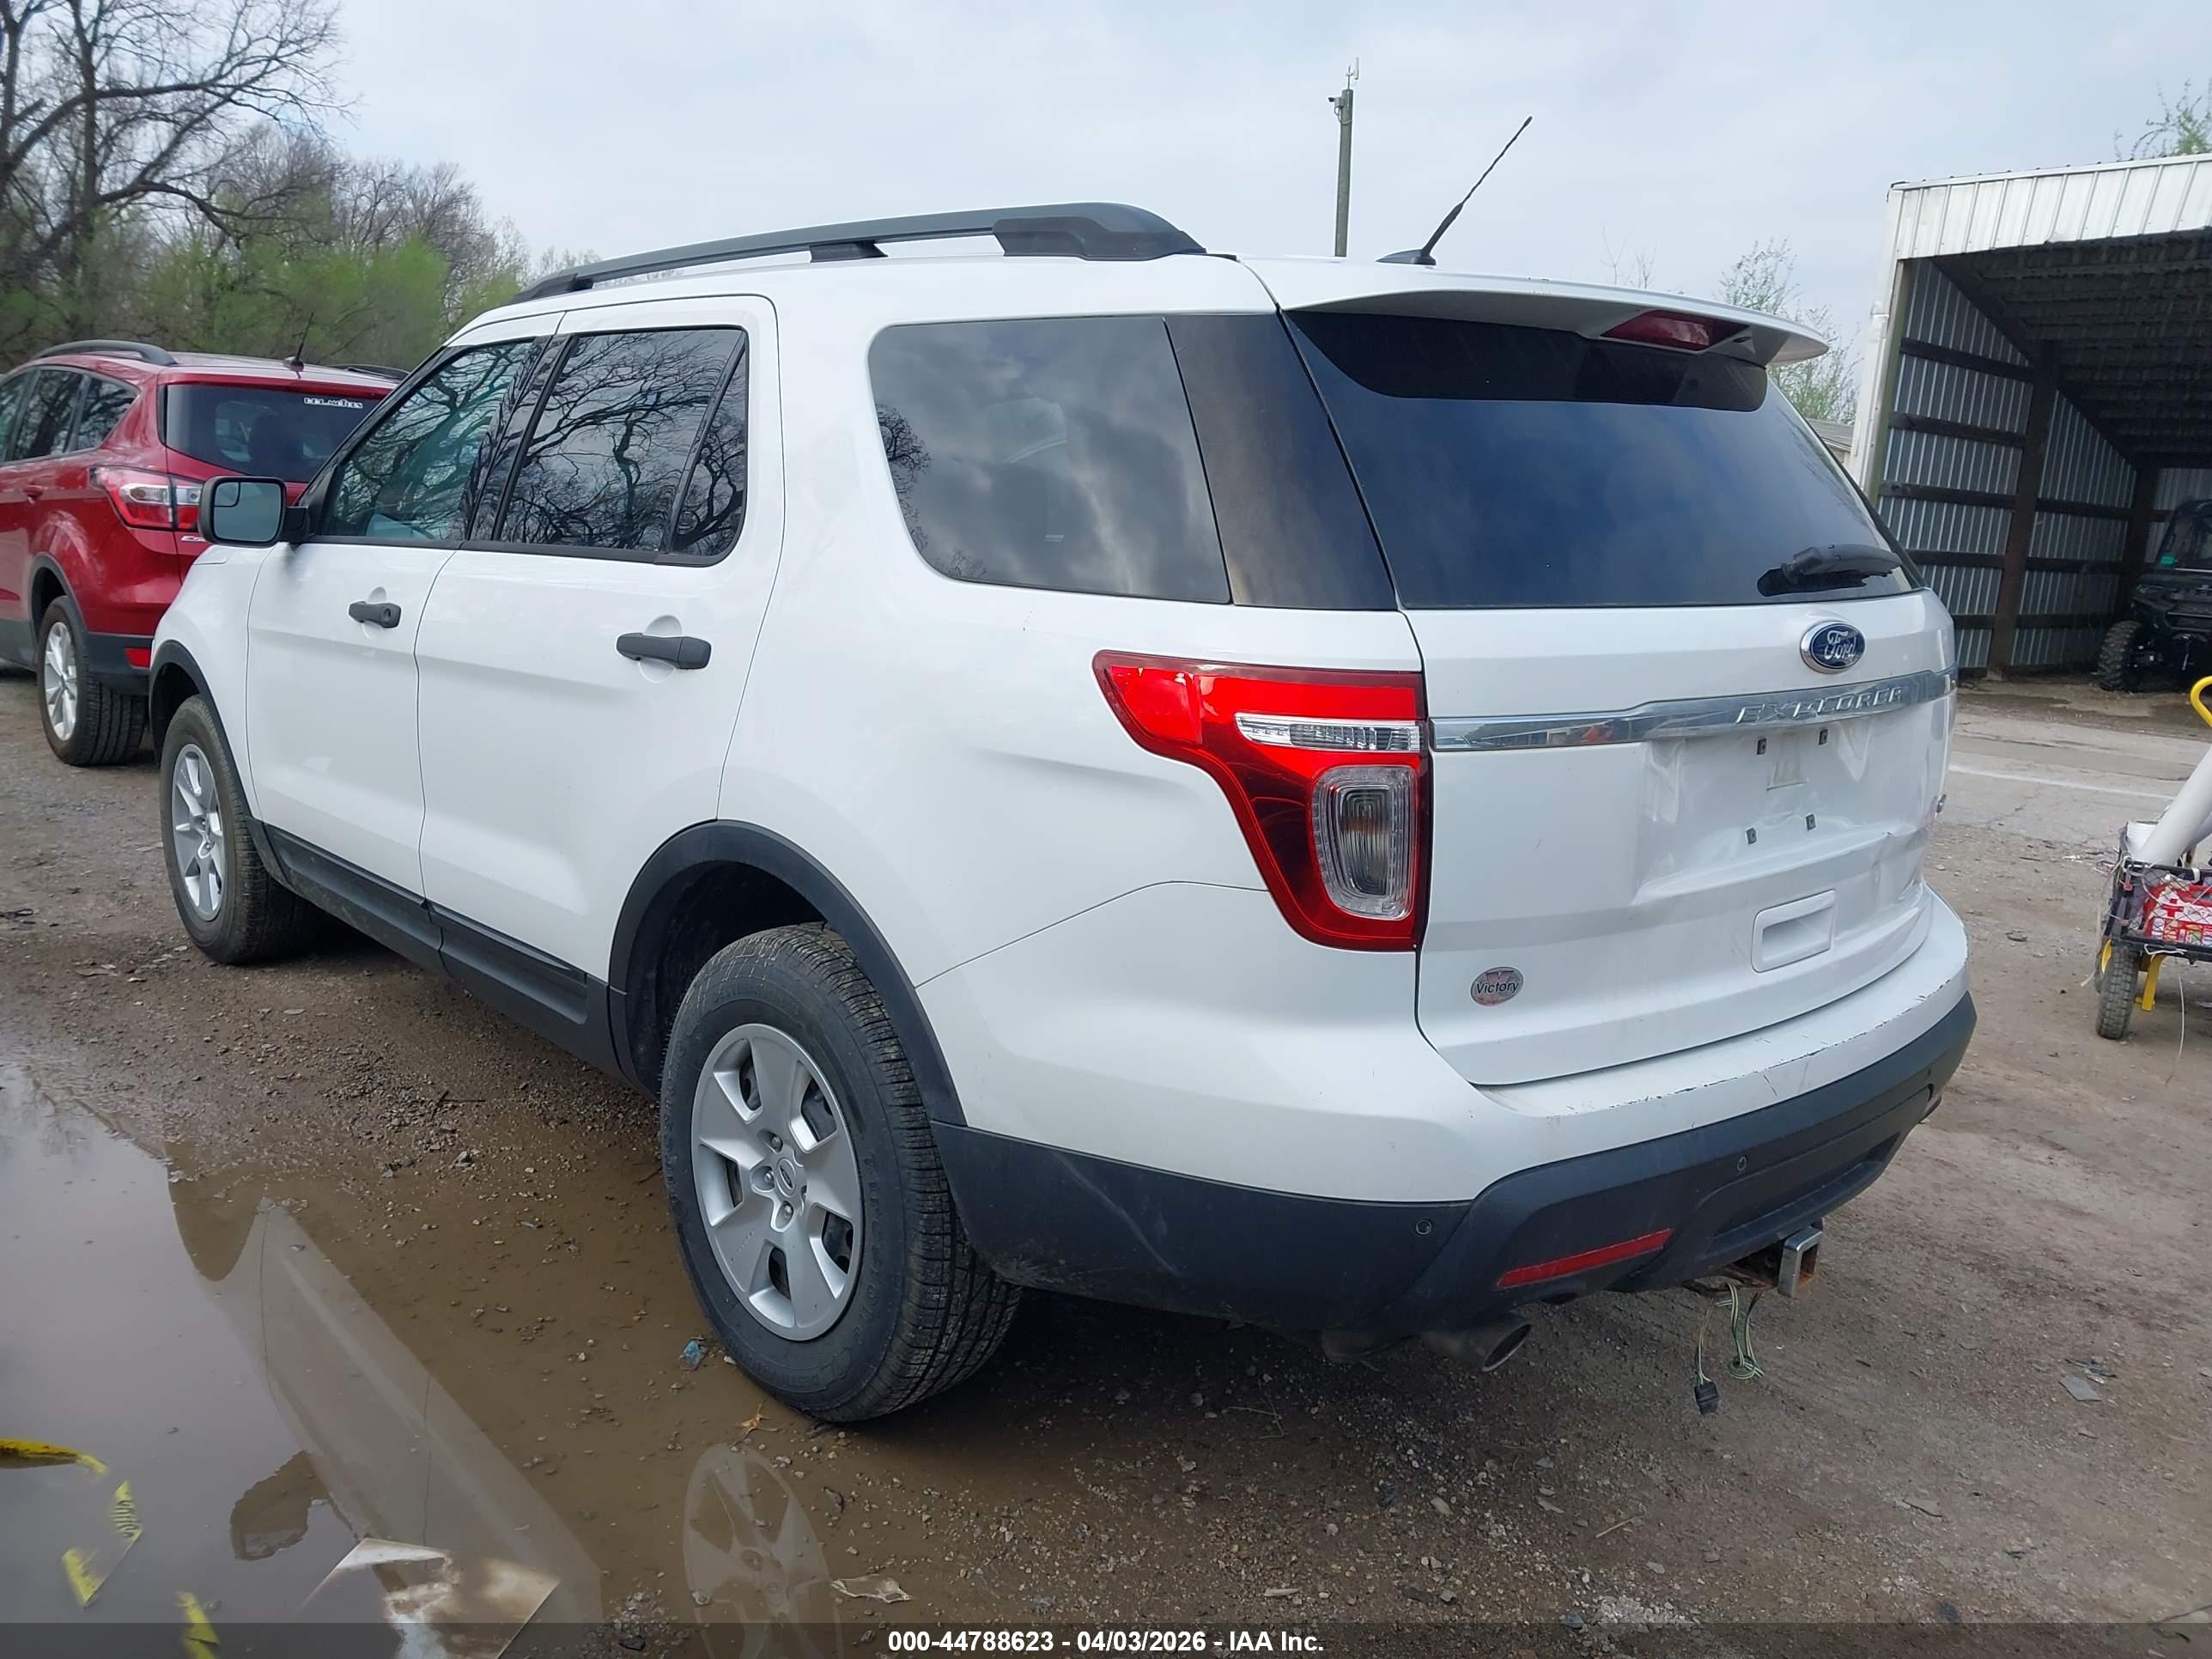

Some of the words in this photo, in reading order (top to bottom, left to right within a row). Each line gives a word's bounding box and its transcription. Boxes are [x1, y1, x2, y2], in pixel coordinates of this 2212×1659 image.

[1824, 629, 1856, 660] Ford
[1734, 686, 1903, 725] EXPLORER
[1476, 981, 1520, 994] Victory
